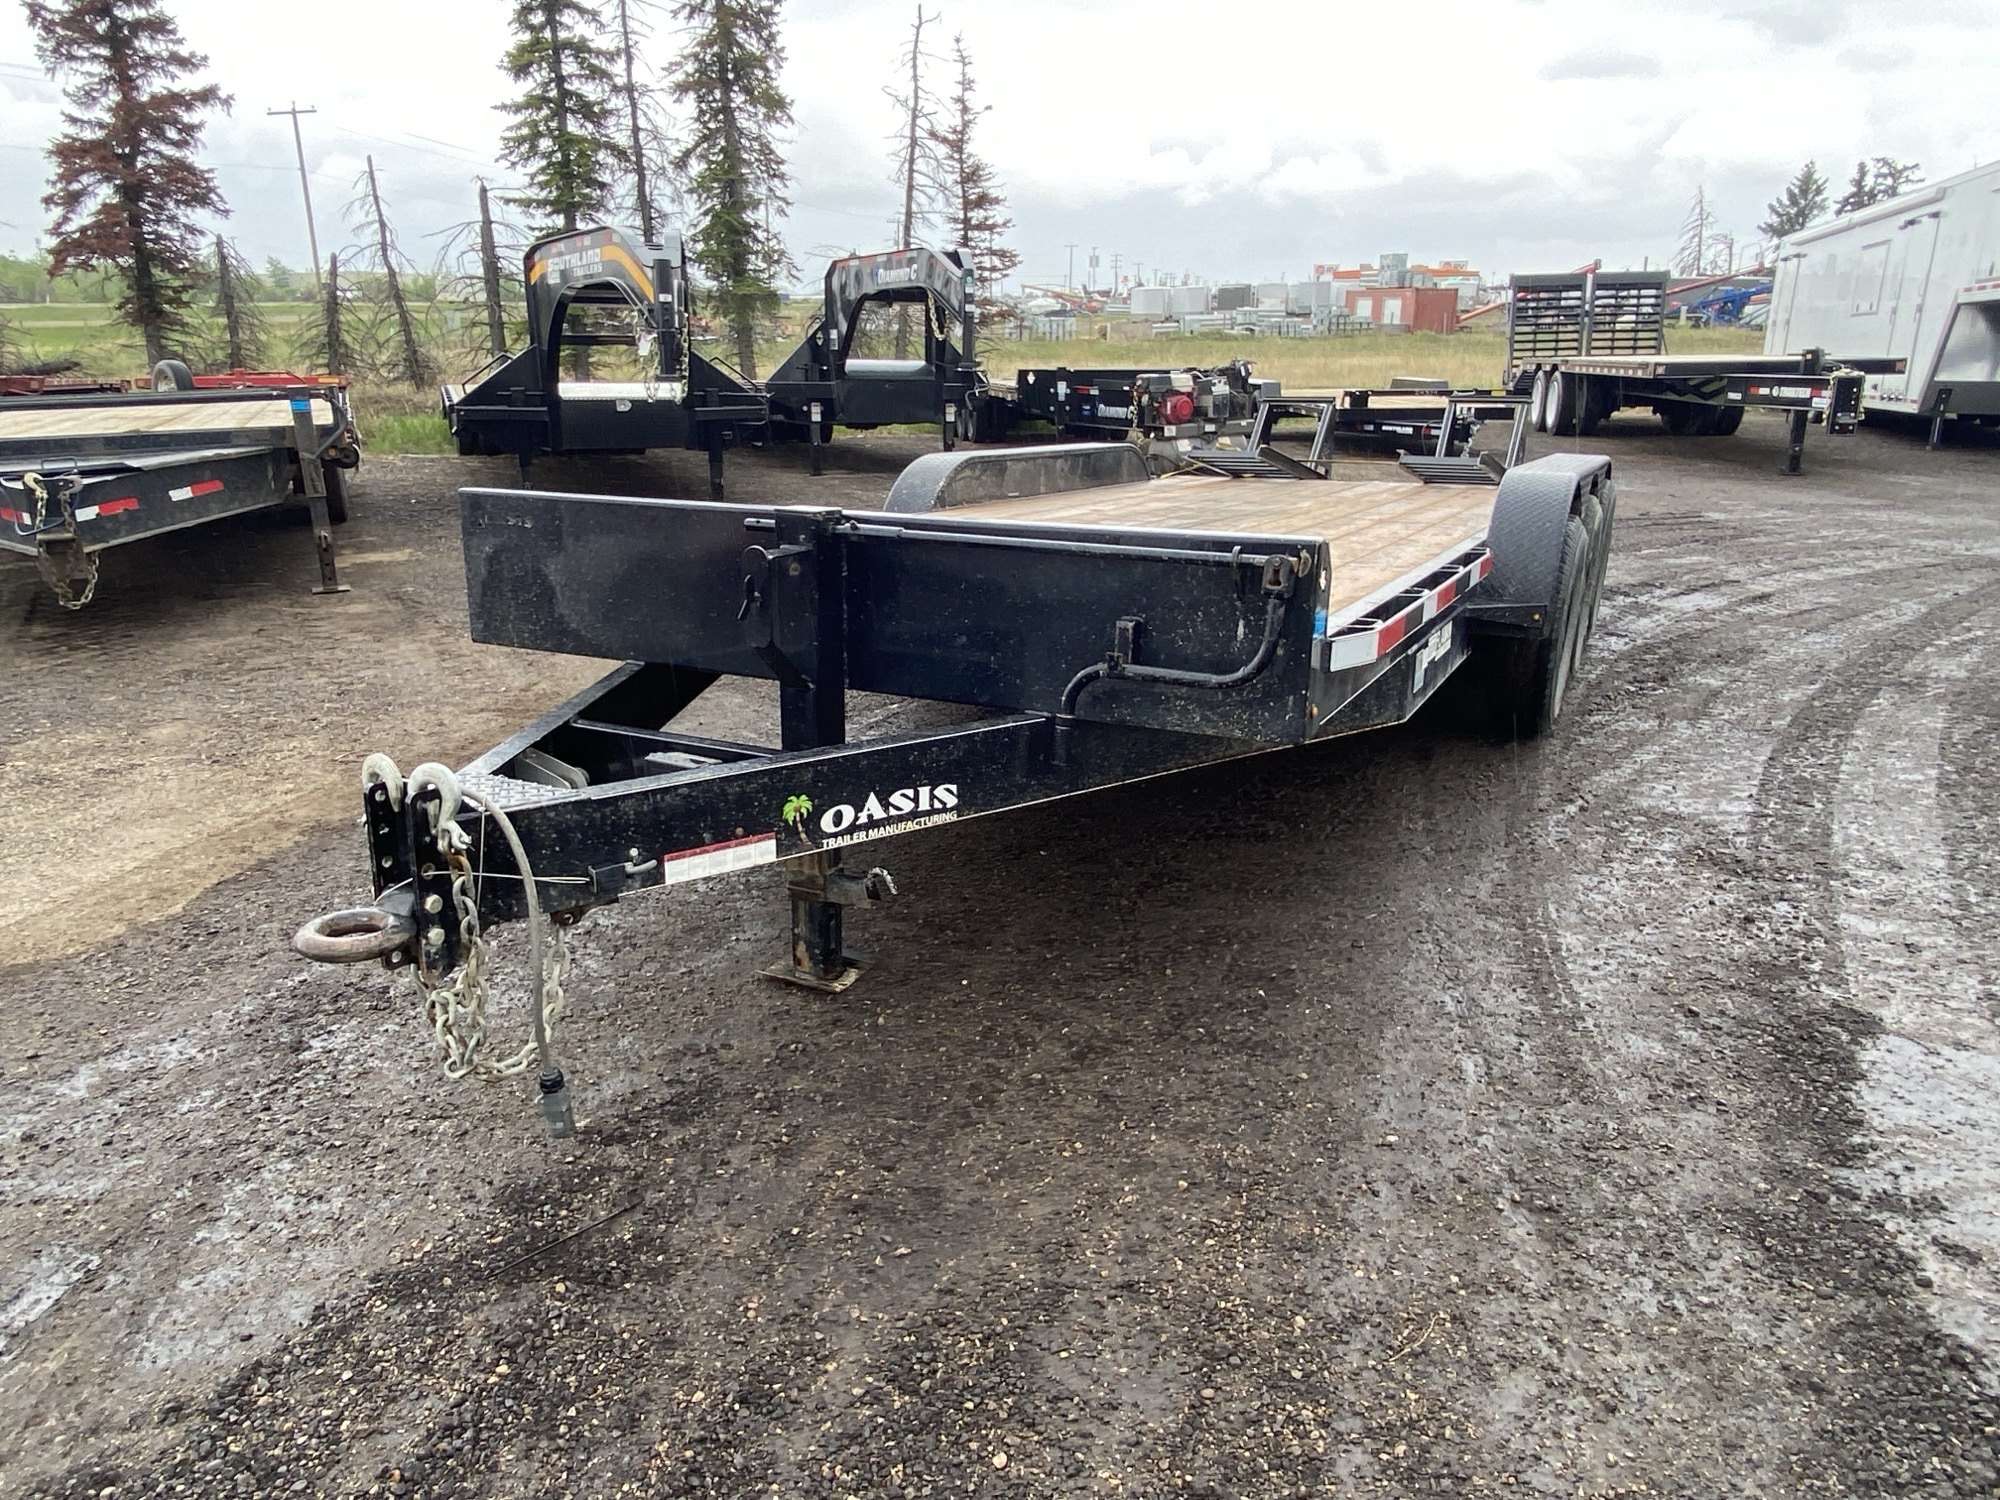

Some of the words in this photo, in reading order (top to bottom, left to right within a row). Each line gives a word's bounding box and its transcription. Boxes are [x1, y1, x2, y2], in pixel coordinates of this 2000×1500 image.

[820, 784, 959, 833] OASIS
[821, 831, 867, 850] TRAILER
[867, 811, 958, 840] MANUFACTURING
